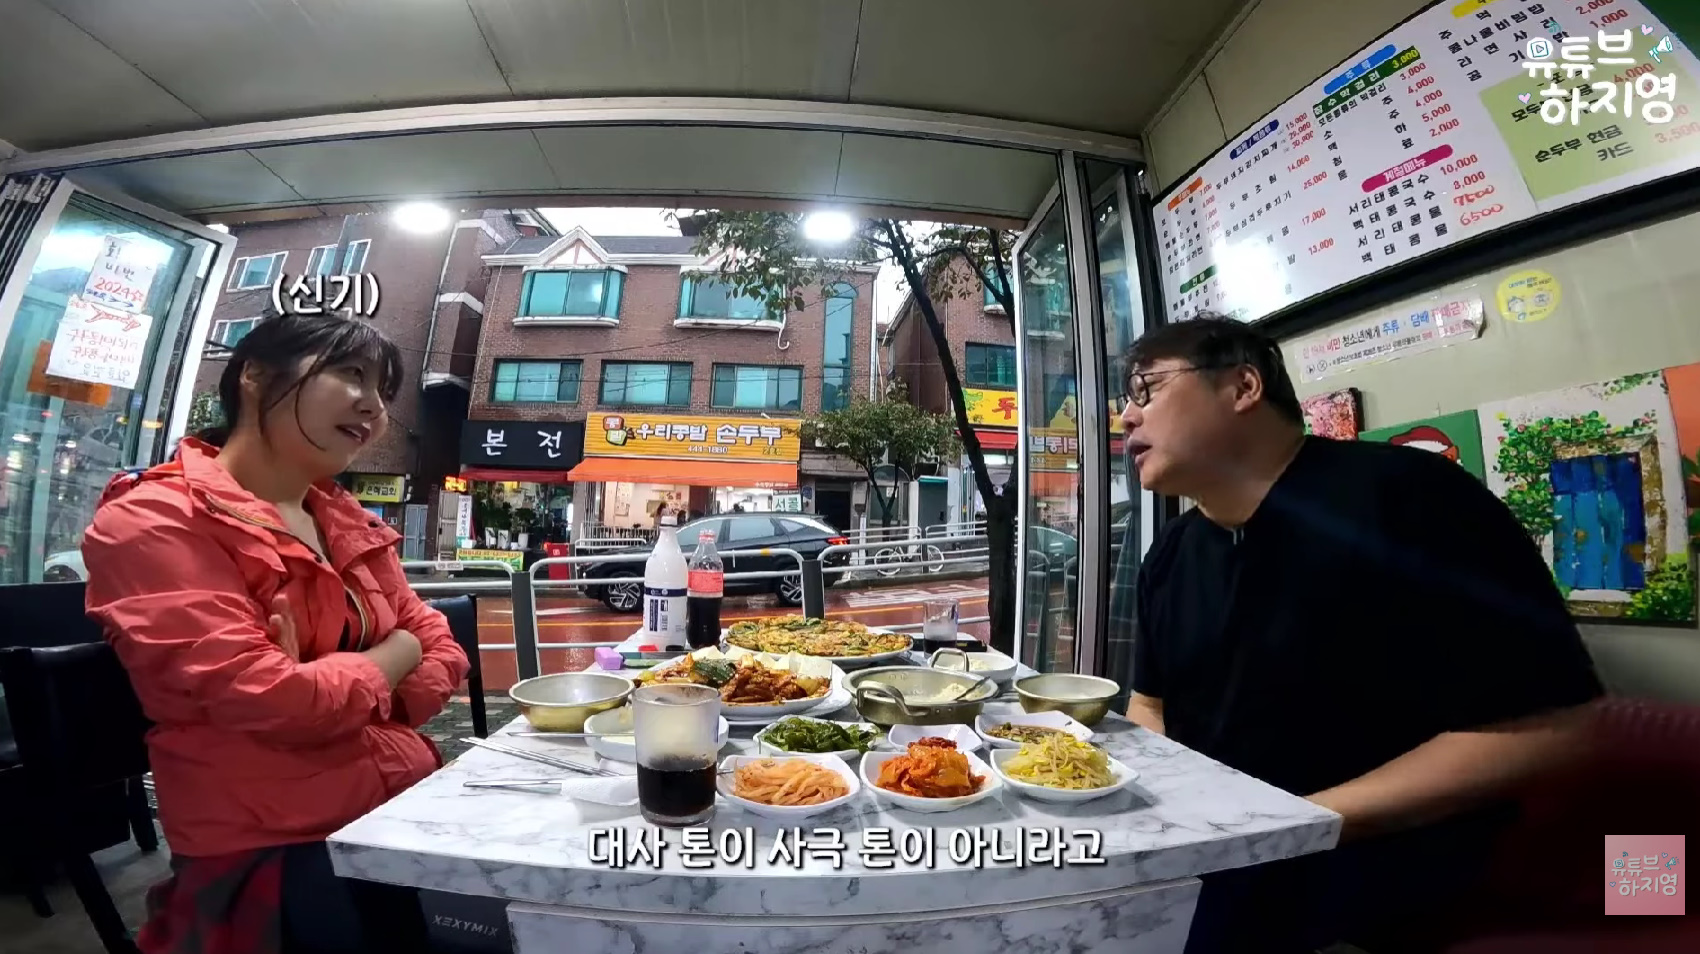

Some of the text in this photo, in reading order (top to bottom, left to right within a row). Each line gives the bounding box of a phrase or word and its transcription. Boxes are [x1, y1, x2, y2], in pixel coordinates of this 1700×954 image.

[1447, 3, 1545, 54] 콩나물비빔밥
[1589, 9, 1628, 28] 1,000
[1391, 49, 1419, 69] 3,000
[1399, 62, 1427, 81] 3,000
[1323, 94, 1394, 141] 소주
[1407, 75, 1435, 95] 4,000
[1415, 89, 1443, 108] 4,000
[1421, 103, 1452, 123] 5,000
[1428, 118, 1460, 138] 2,000
[1534, 124, 1624, 163] 순두부 현금
[1596, 141, 1635, 162] 카드
[1287, 154, 1311, 173] 14,000
[1303, 171, 1328, 190] 25,000
[1349, 153, 1479, 216] 서리태콩국수 10,000
[1302, 207, 1327, 226] 17,000
[1459, 203, 1505, 228] 6500
[1357, 204, 1444, 249] 서리태콩물
[1308, 237, 1335, 256] 13,000
[1342, 325, 1381, 348] 청소년에게
[1382, 319, 1400, 336] 주류
[1411, 310, 1430, 328] 담배
[715, 423, 783, 446] 손두부
